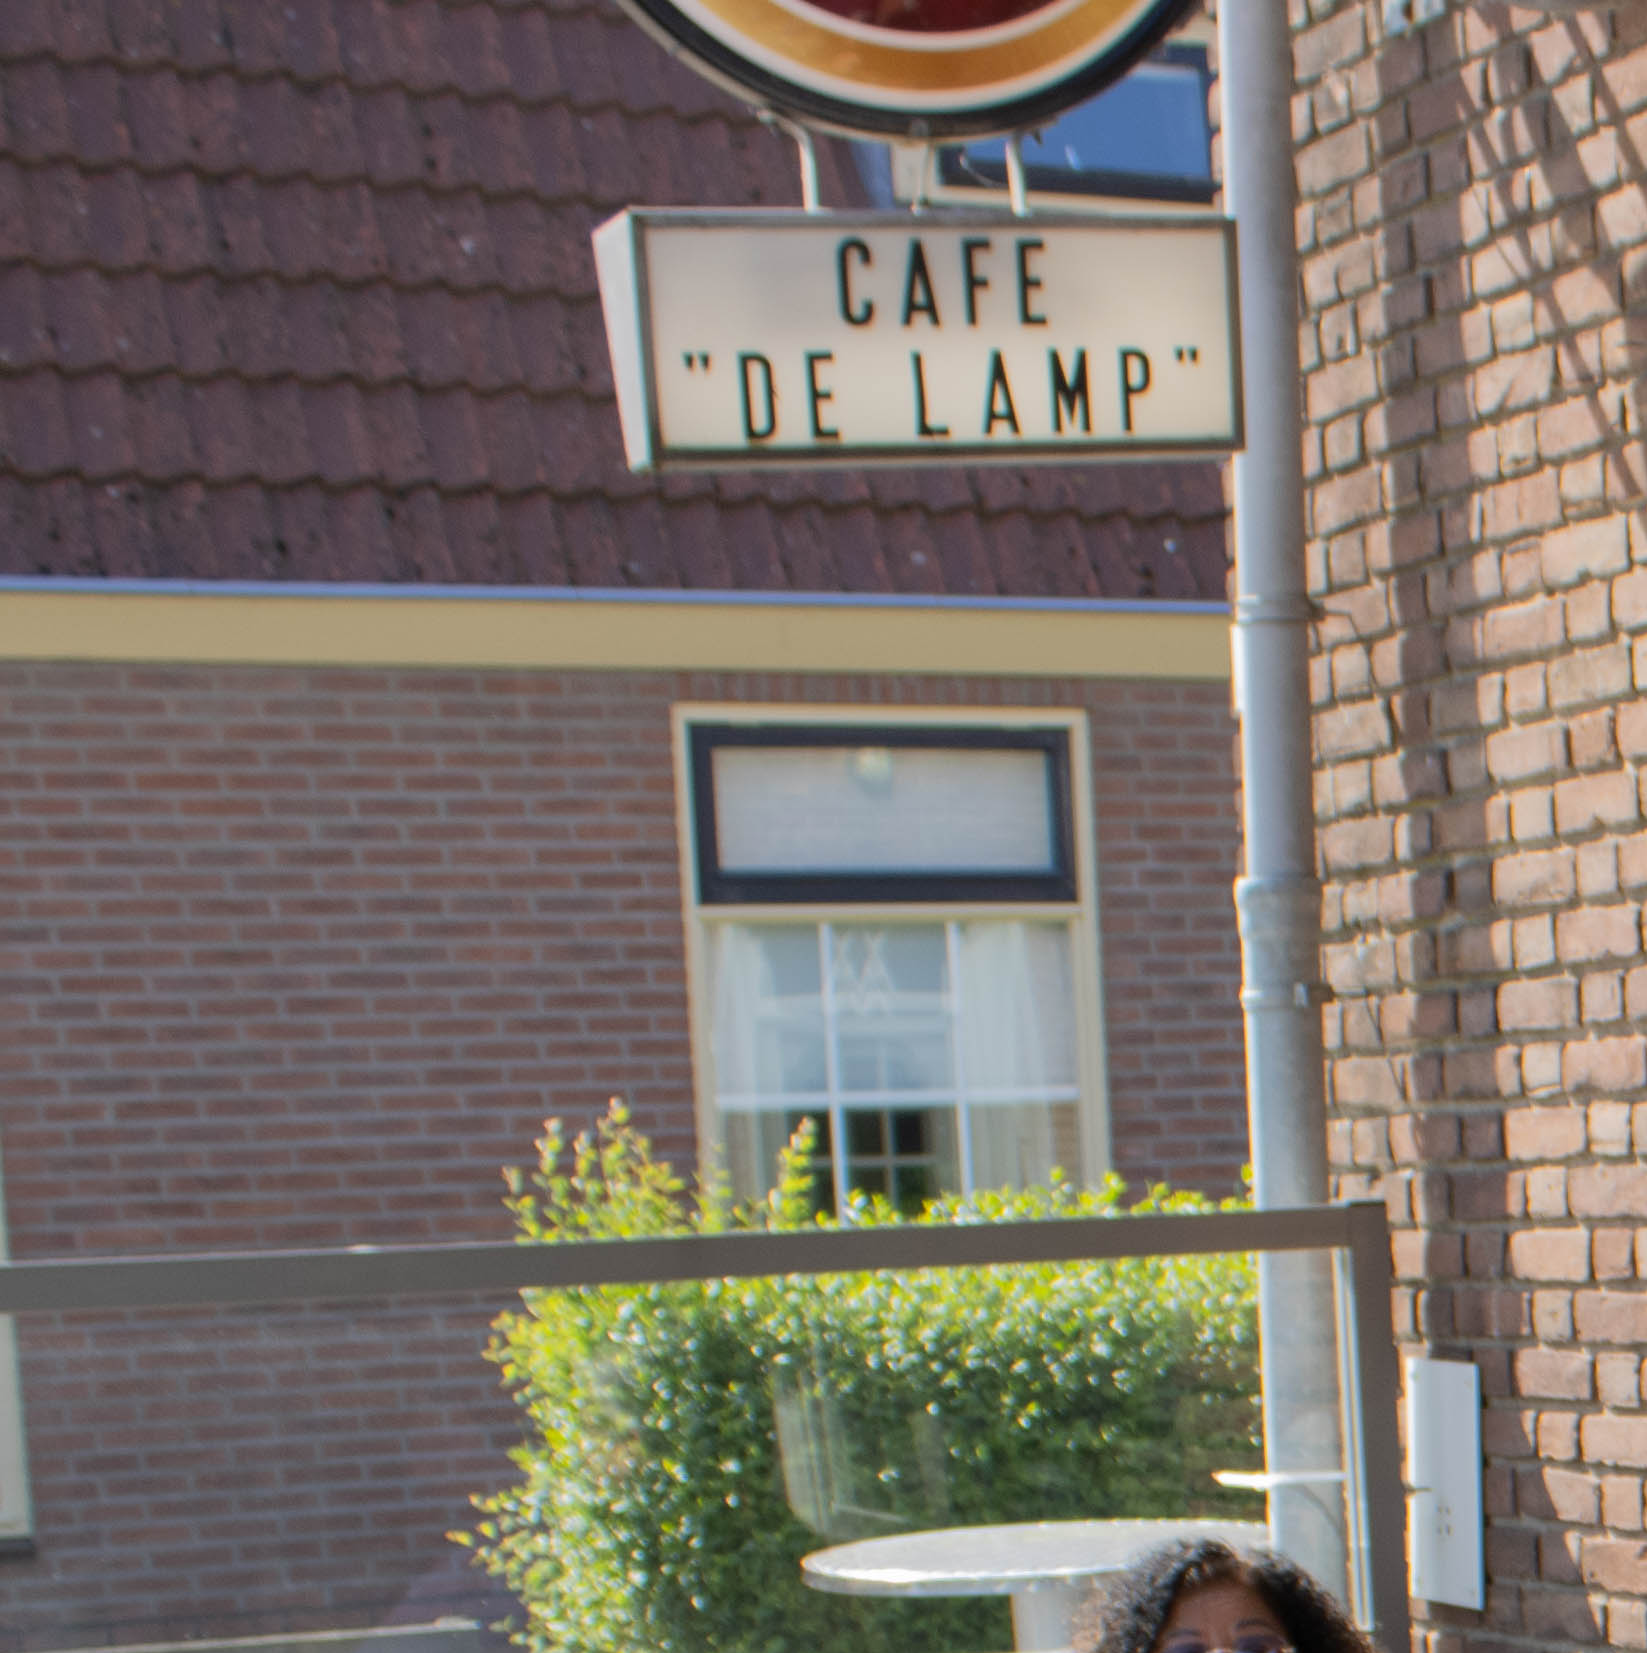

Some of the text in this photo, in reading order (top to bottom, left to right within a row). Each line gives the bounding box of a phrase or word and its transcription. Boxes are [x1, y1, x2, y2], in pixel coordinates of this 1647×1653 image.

[836, 237, 1049, 328] CAFE
[683, 346, 1199, 445] "DE LAMP"
